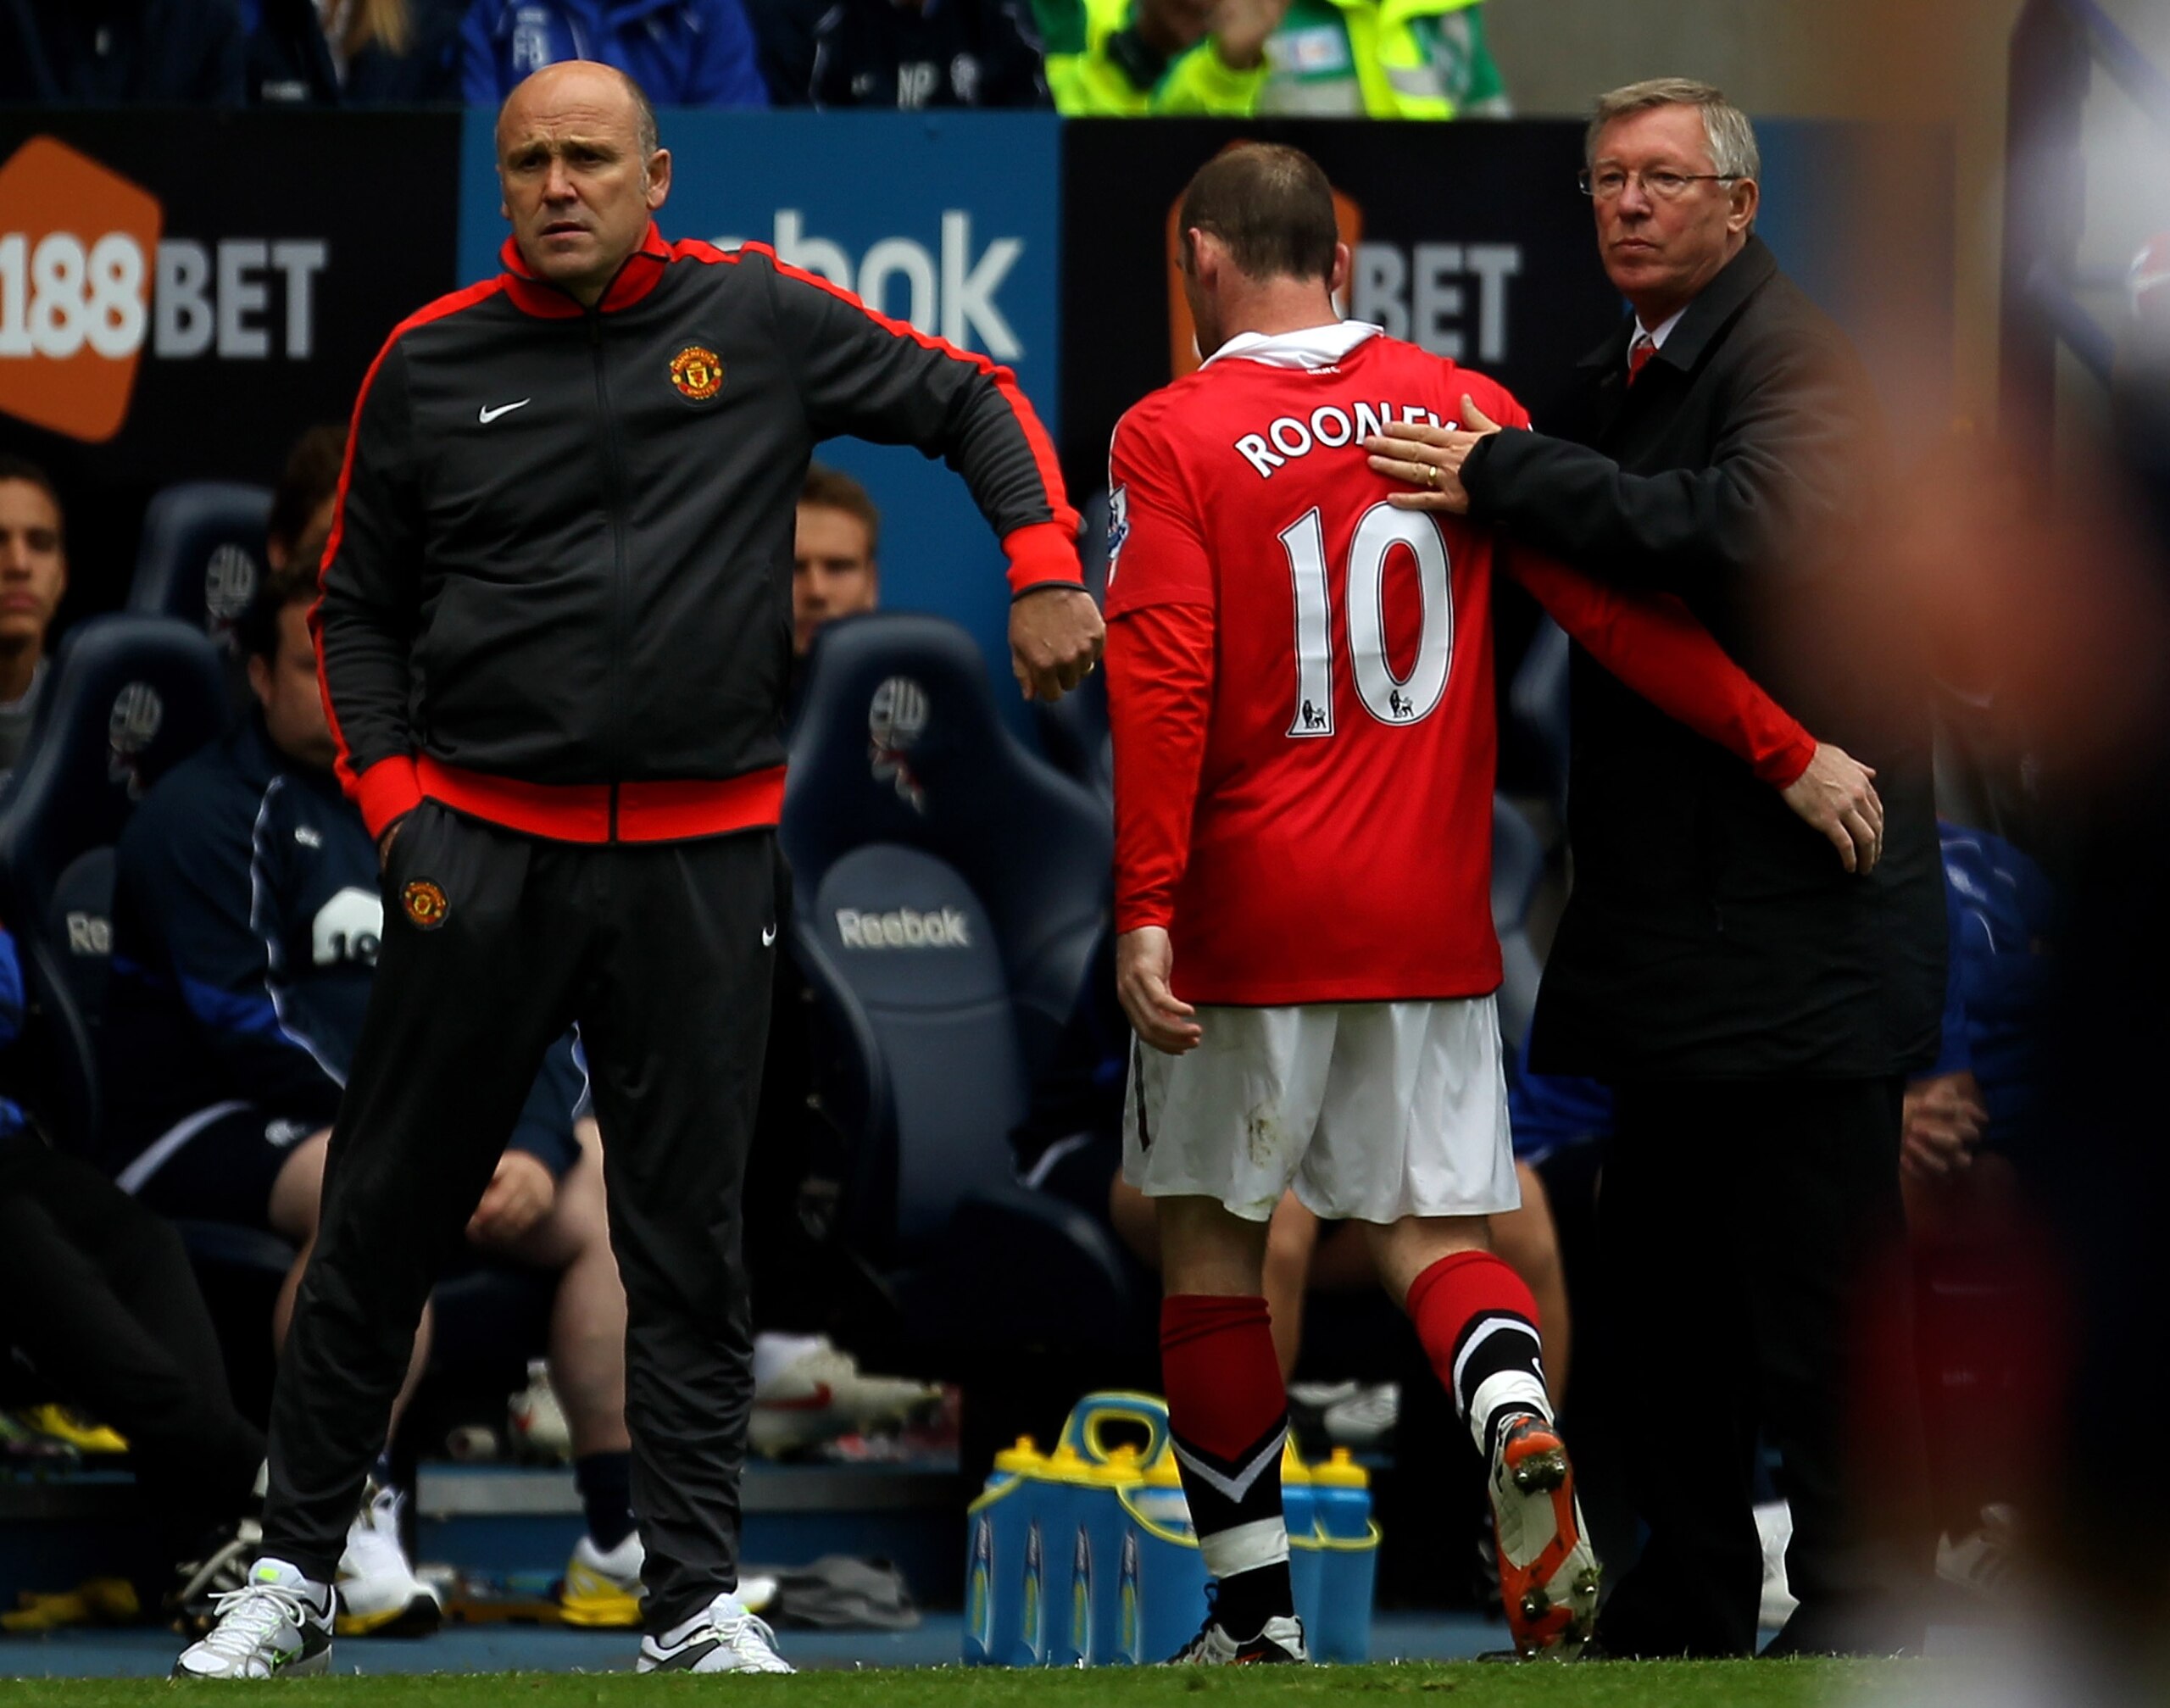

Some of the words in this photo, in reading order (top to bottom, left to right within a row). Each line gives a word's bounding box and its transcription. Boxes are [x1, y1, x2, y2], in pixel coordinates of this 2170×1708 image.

[0, 231, 328, 359] 188BET
[1277, 499, 1454, 737] 10
[835, 906, 971, 949] Reebok
